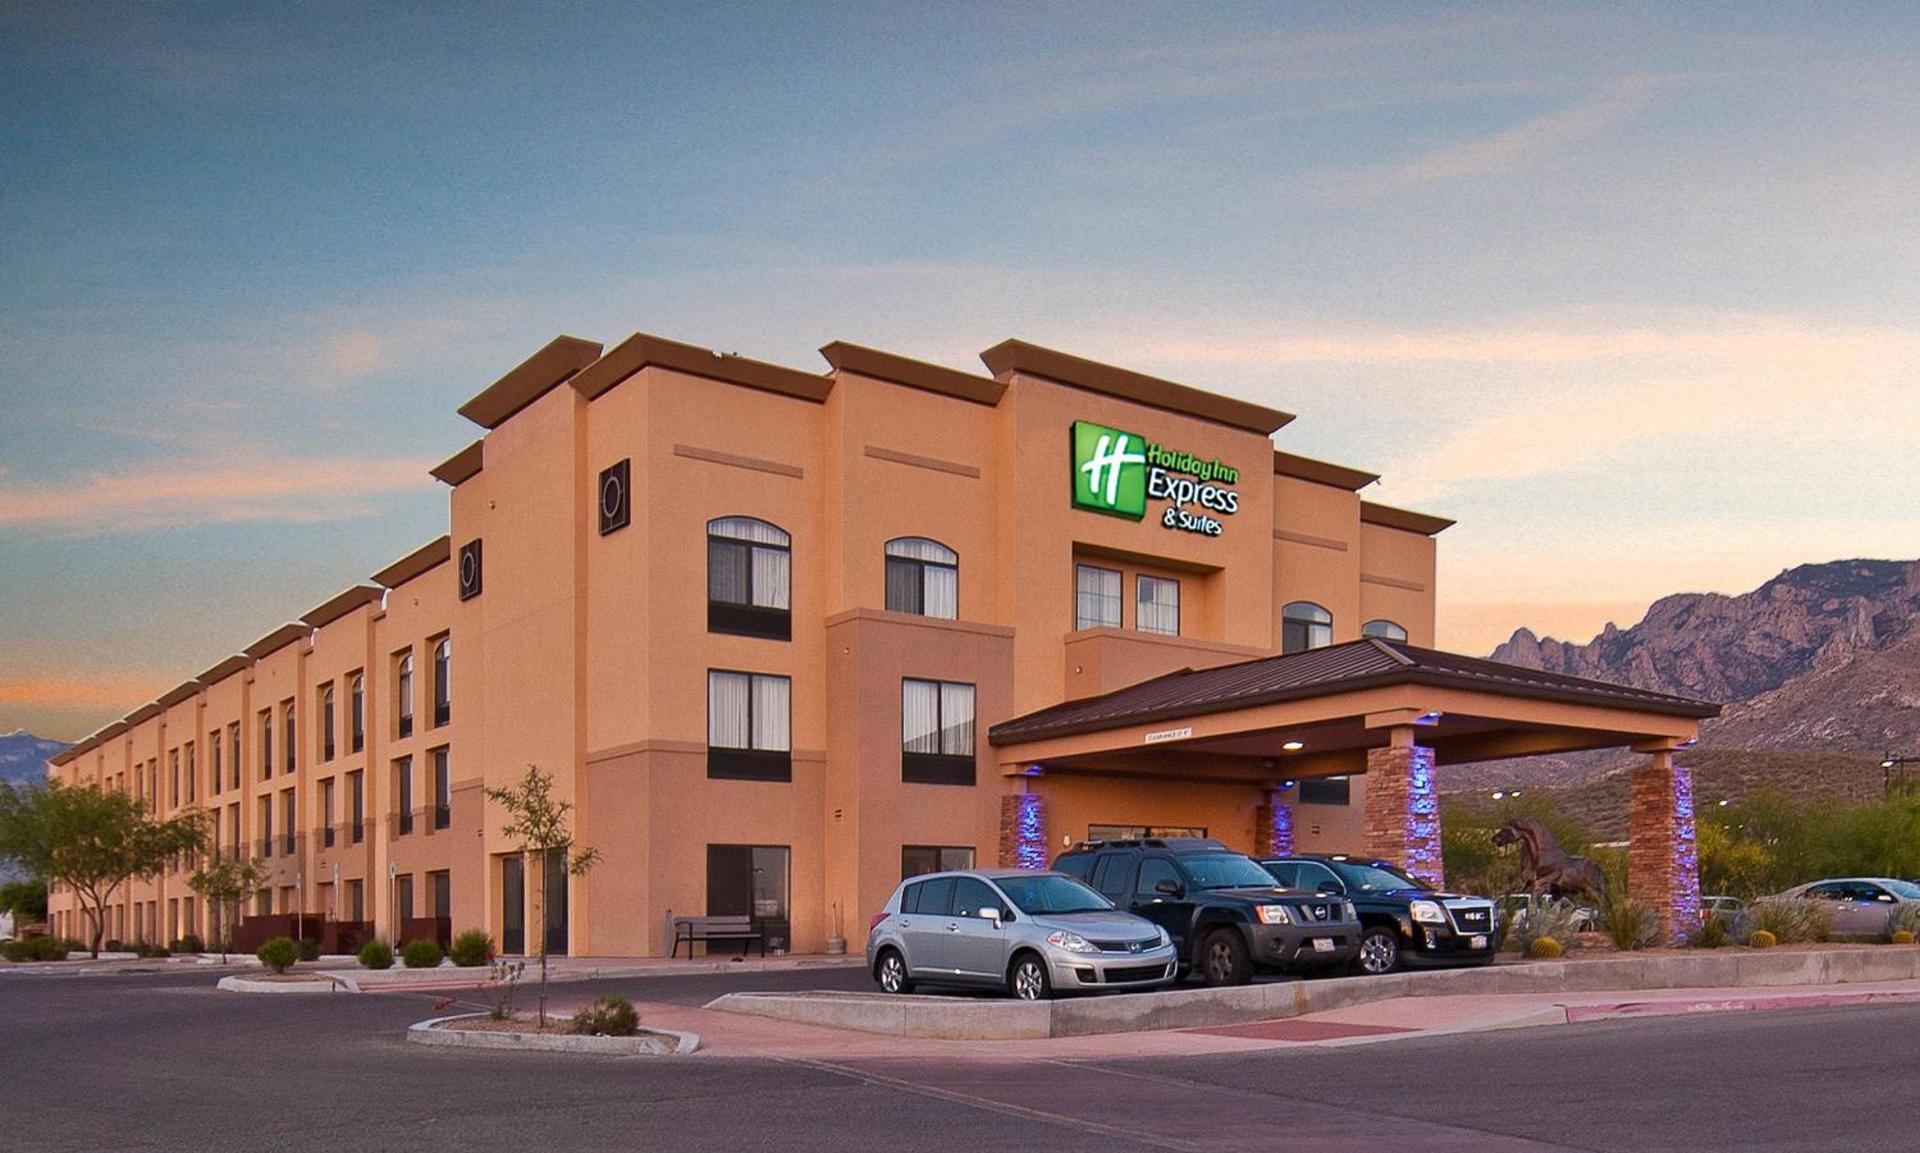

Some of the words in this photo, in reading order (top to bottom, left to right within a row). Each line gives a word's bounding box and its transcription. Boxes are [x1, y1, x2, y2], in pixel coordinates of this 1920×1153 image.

[1148, 443, 1212, 480] Holiday
[1148, 467, 1239, 513] Express
[1164, 507, 1176, 526] &
[1179, 511, 1222, 534] Suites
